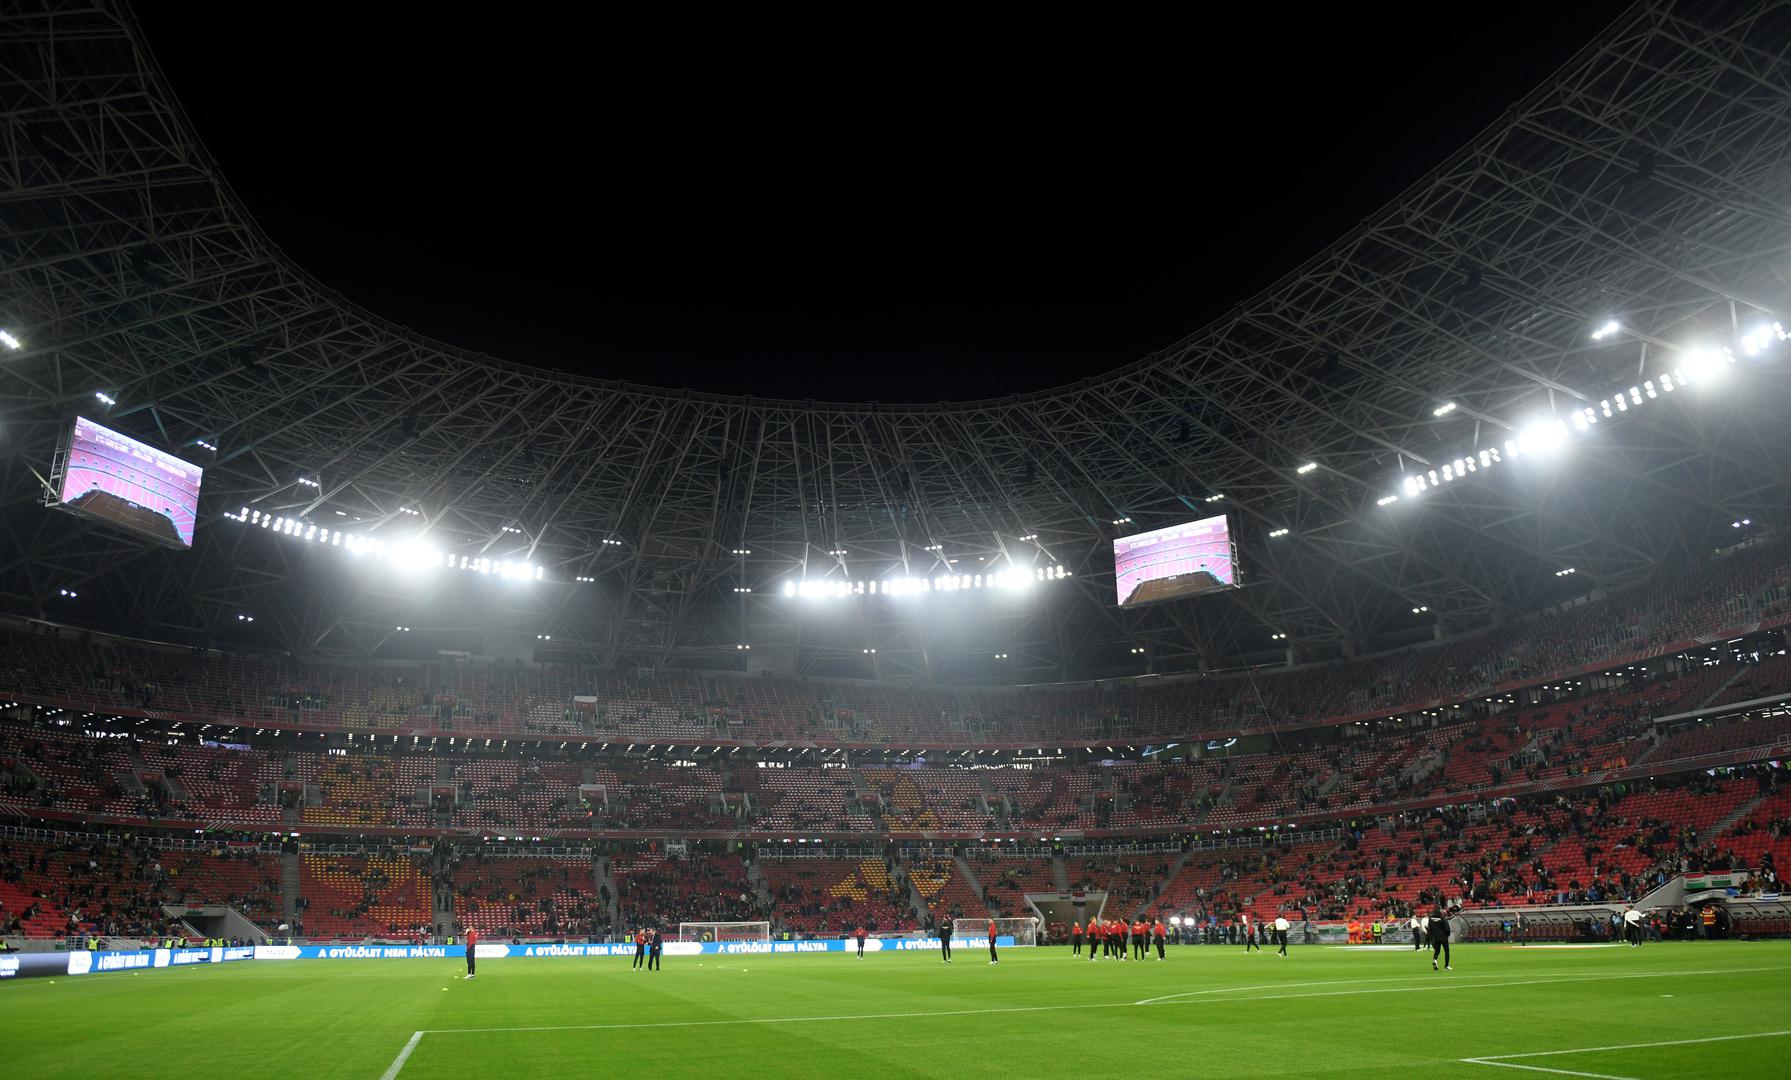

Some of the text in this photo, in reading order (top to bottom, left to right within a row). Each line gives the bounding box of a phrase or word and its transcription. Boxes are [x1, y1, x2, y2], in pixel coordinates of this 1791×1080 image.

[718, 944, 726, 953] A
[775, 944, 795, 952] NEM
[896, 941, 903, 950] A
[318, 948, 327, 958] A
[384, 948, 408, 958] NEM
[410, 945, 445, 958] PÁLYA!
[525, 947, 533, 956] A
[586, 946, 608, 956] NEM
